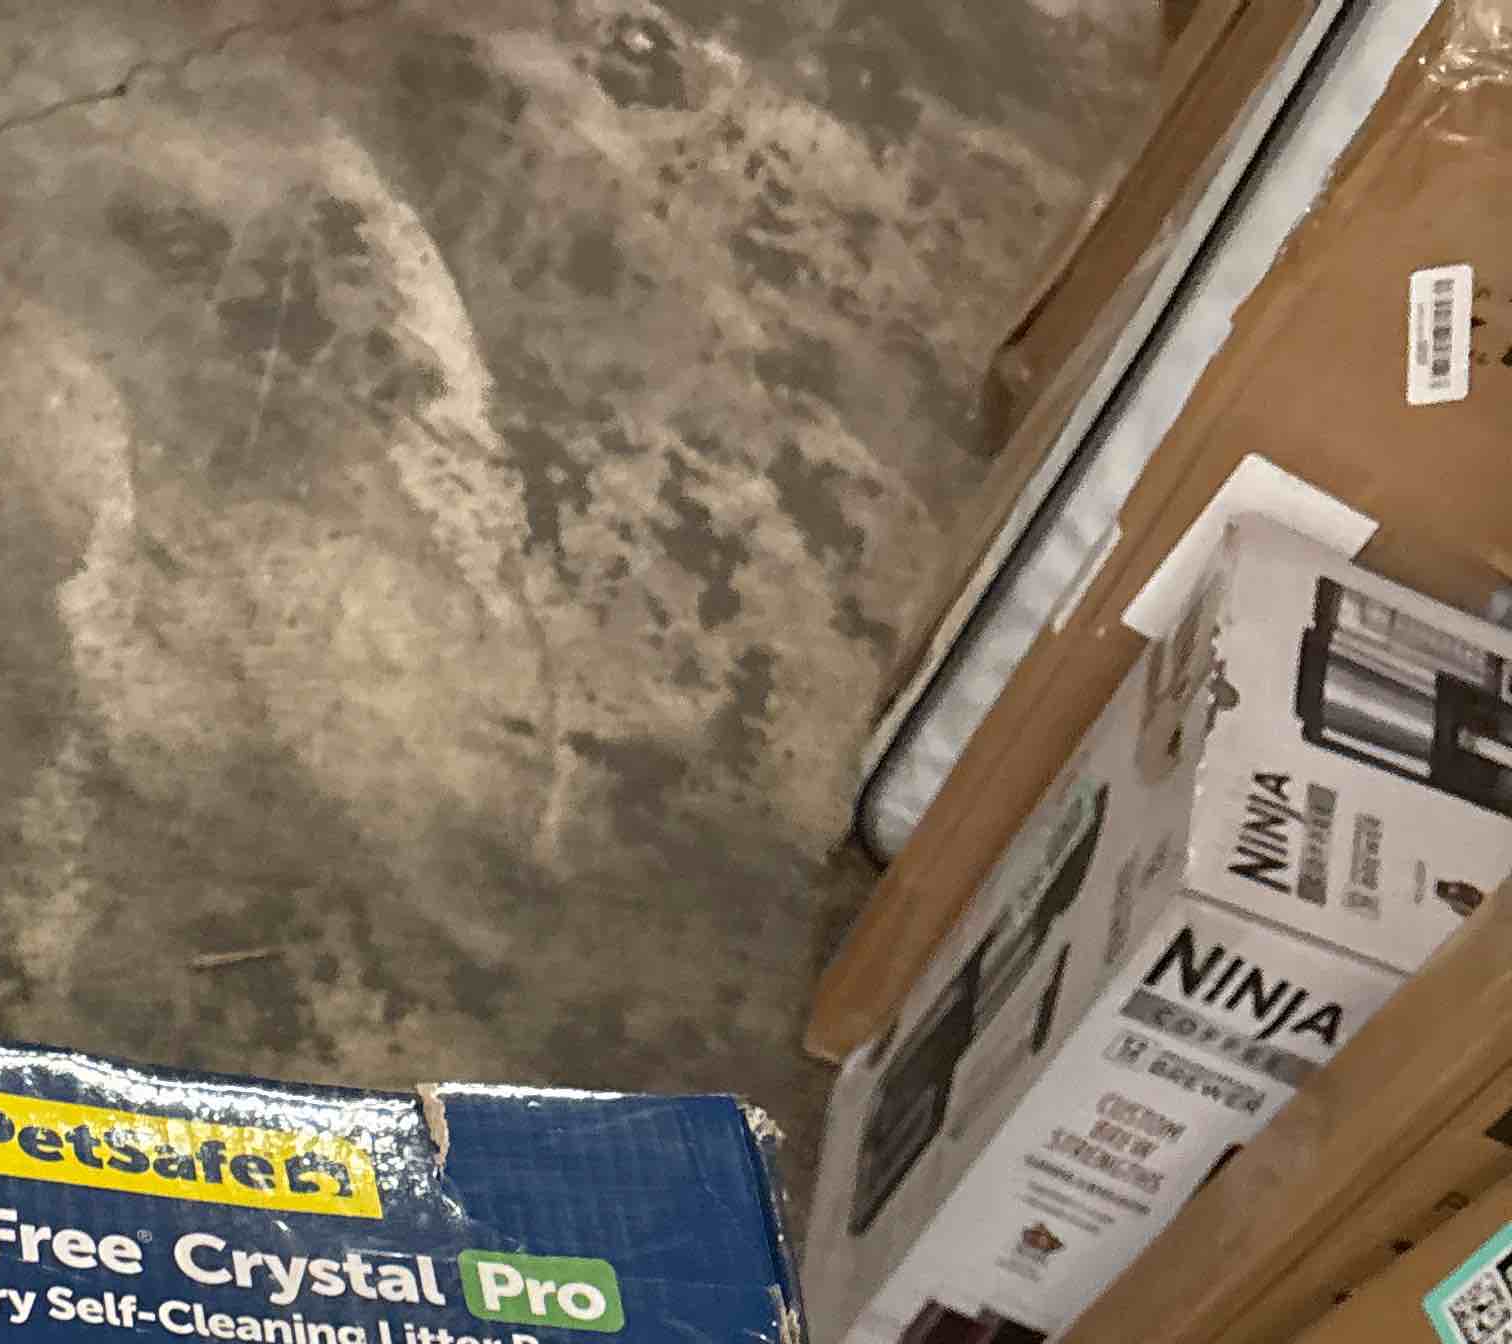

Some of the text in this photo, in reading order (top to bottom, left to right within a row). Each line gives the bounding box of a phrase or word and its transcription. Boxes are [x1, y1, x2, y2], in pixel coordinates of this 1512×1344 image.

[1229, 772, 1305, 894] NINJA
[1143, 927, 1343, 1047] NINJA
[173, 1231, 446, 1306] Crystal
[478, 1261, 606, 1322] Pro
